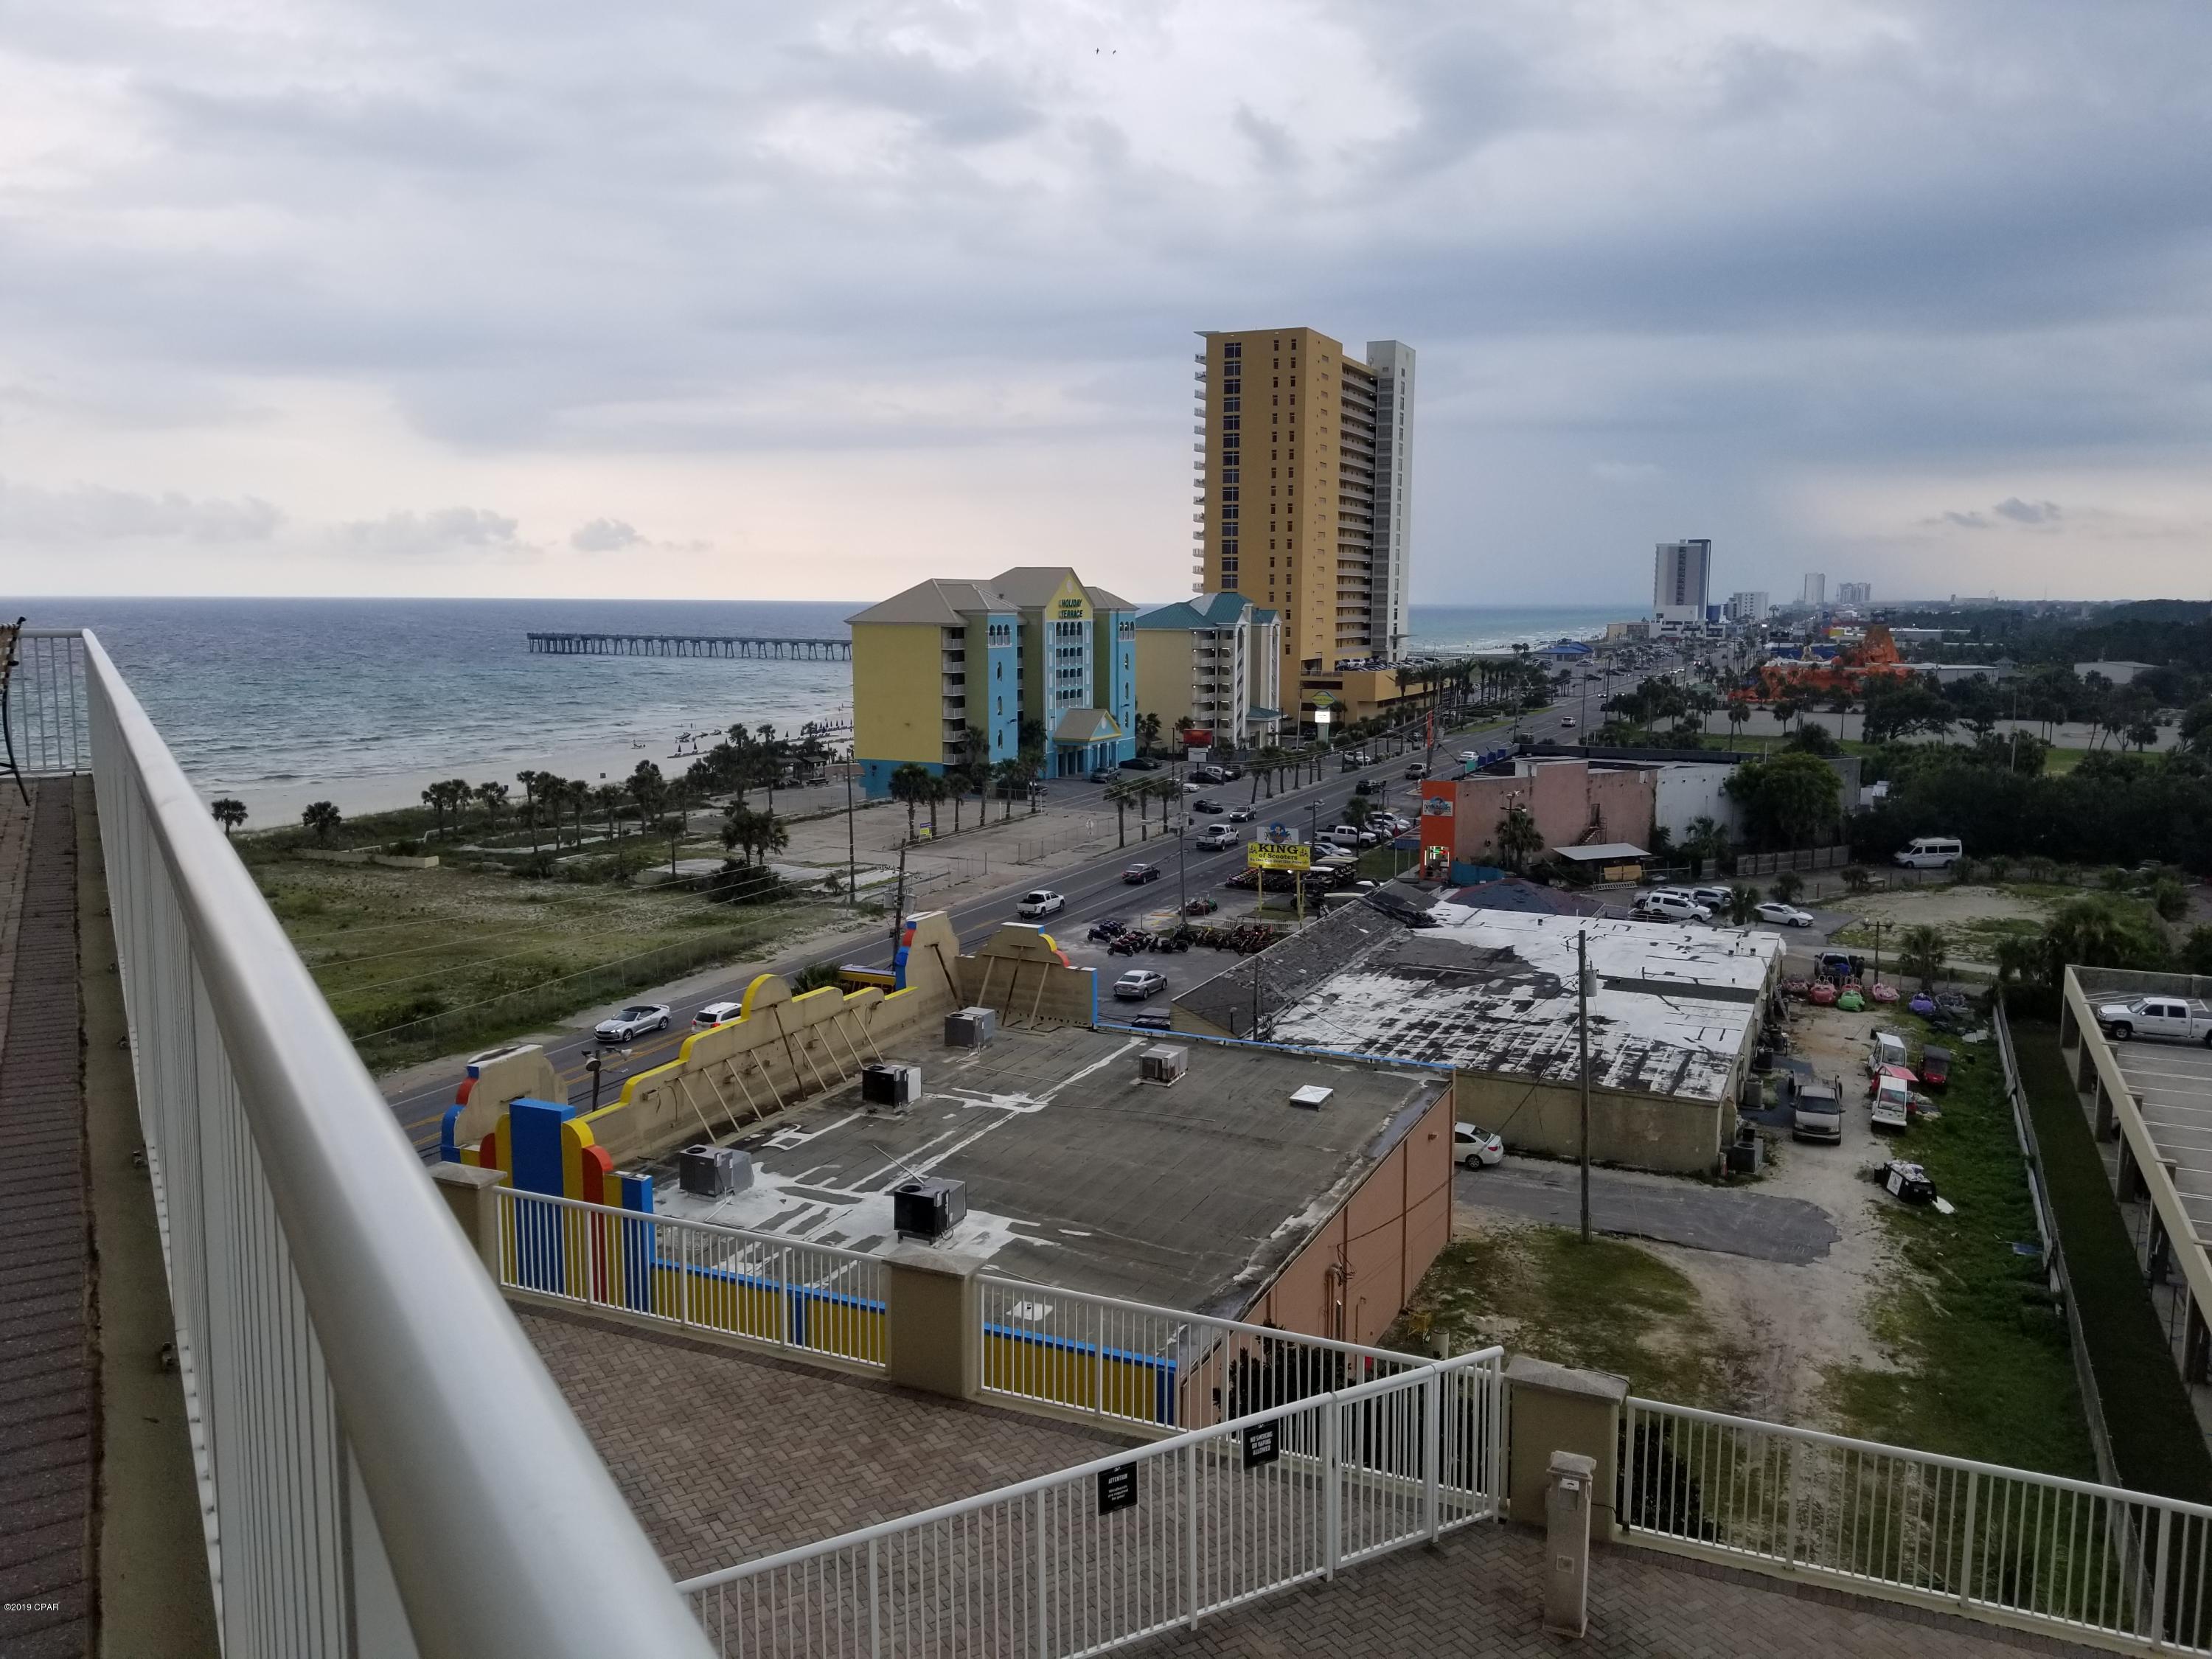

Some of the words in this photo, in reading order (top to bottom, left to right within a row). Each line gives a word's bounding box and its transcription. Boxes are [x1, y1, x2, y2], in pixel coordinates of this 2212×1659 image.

[1062, 599, 1082, 608] HOLIDAY
[1258, 844, 1298, 854] KING
[1256, 1431, 1273, 1441] SMOKING
[1257, 1438, 1272, 1447] VAPING
[1253, 1444, 1271, 1455] ALLOWED
[1108, 1473, 1128, 1484] ATTENTION
